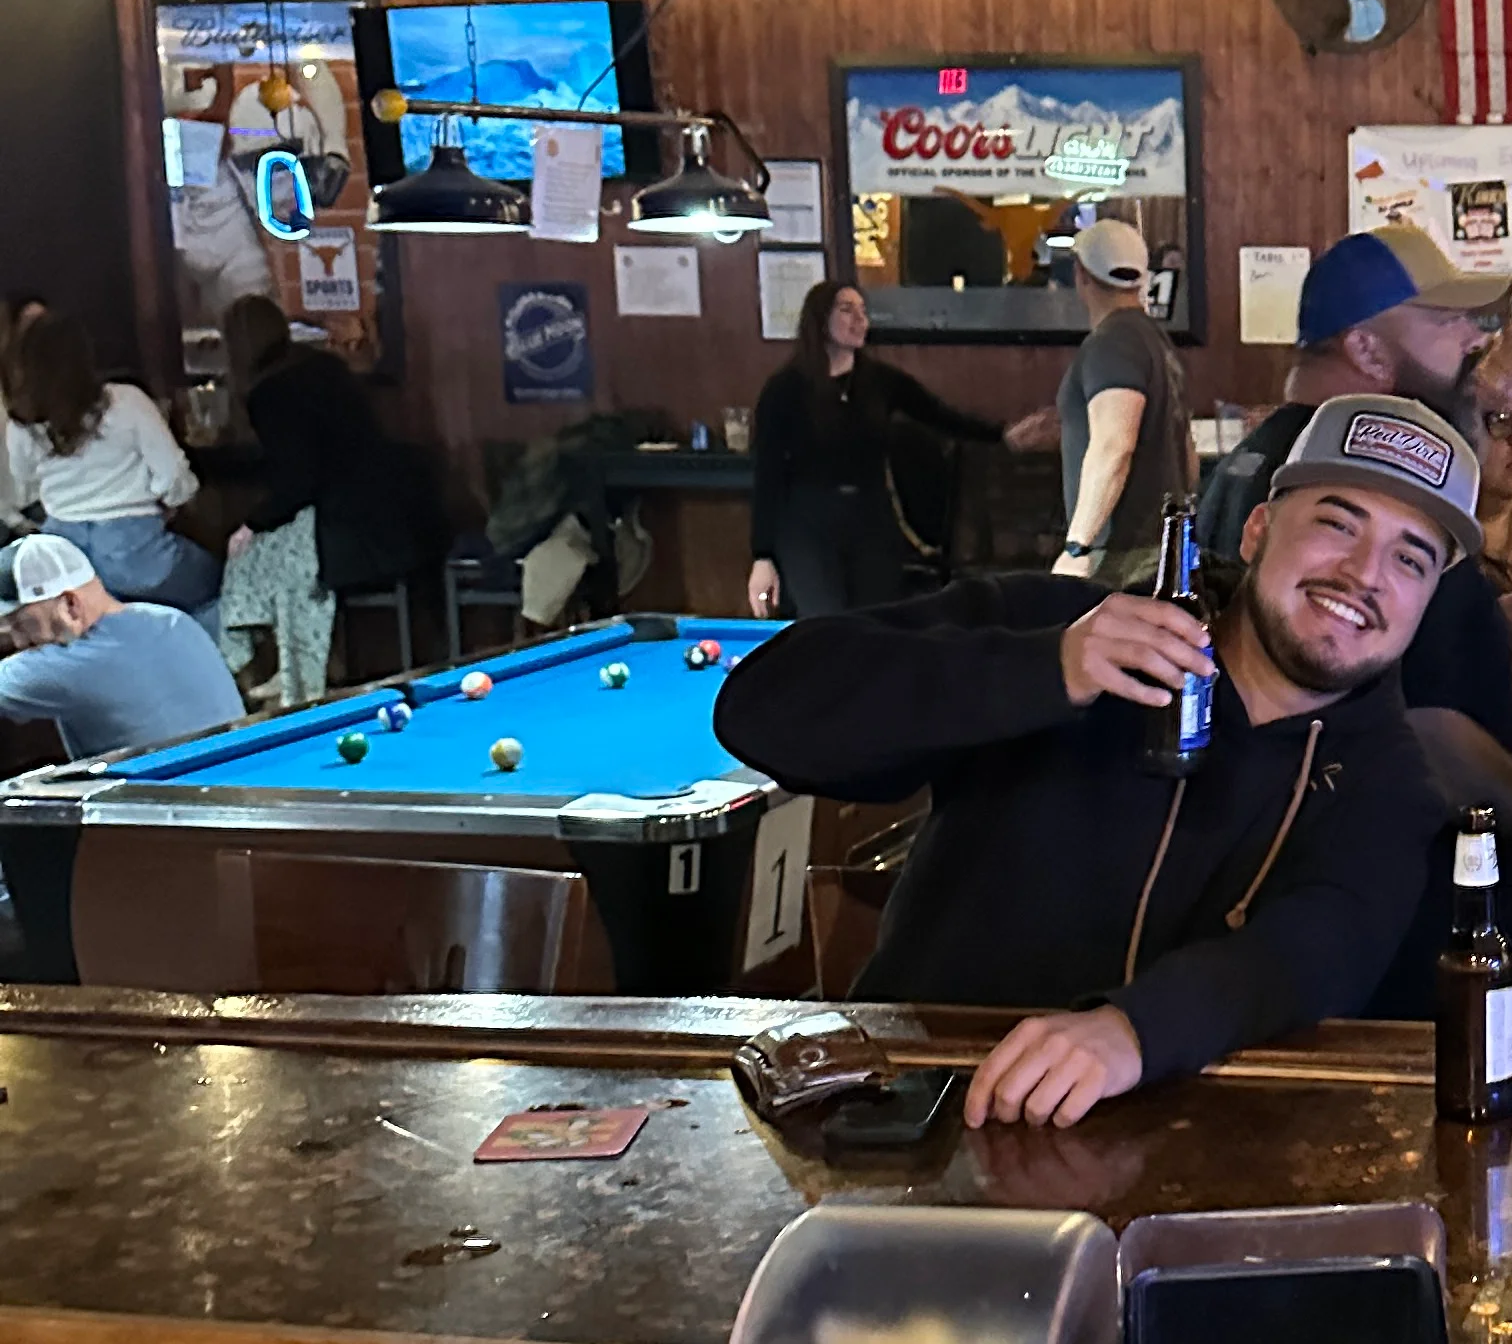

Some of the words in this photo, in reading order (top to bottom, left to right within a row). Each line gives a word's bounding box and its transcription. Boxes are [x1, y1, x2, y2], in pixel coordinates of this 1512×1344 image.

[880, 106, 1014, 161] Coors
[678, 848, 694, 890] 1
[763, 849, 787, 945] 1
